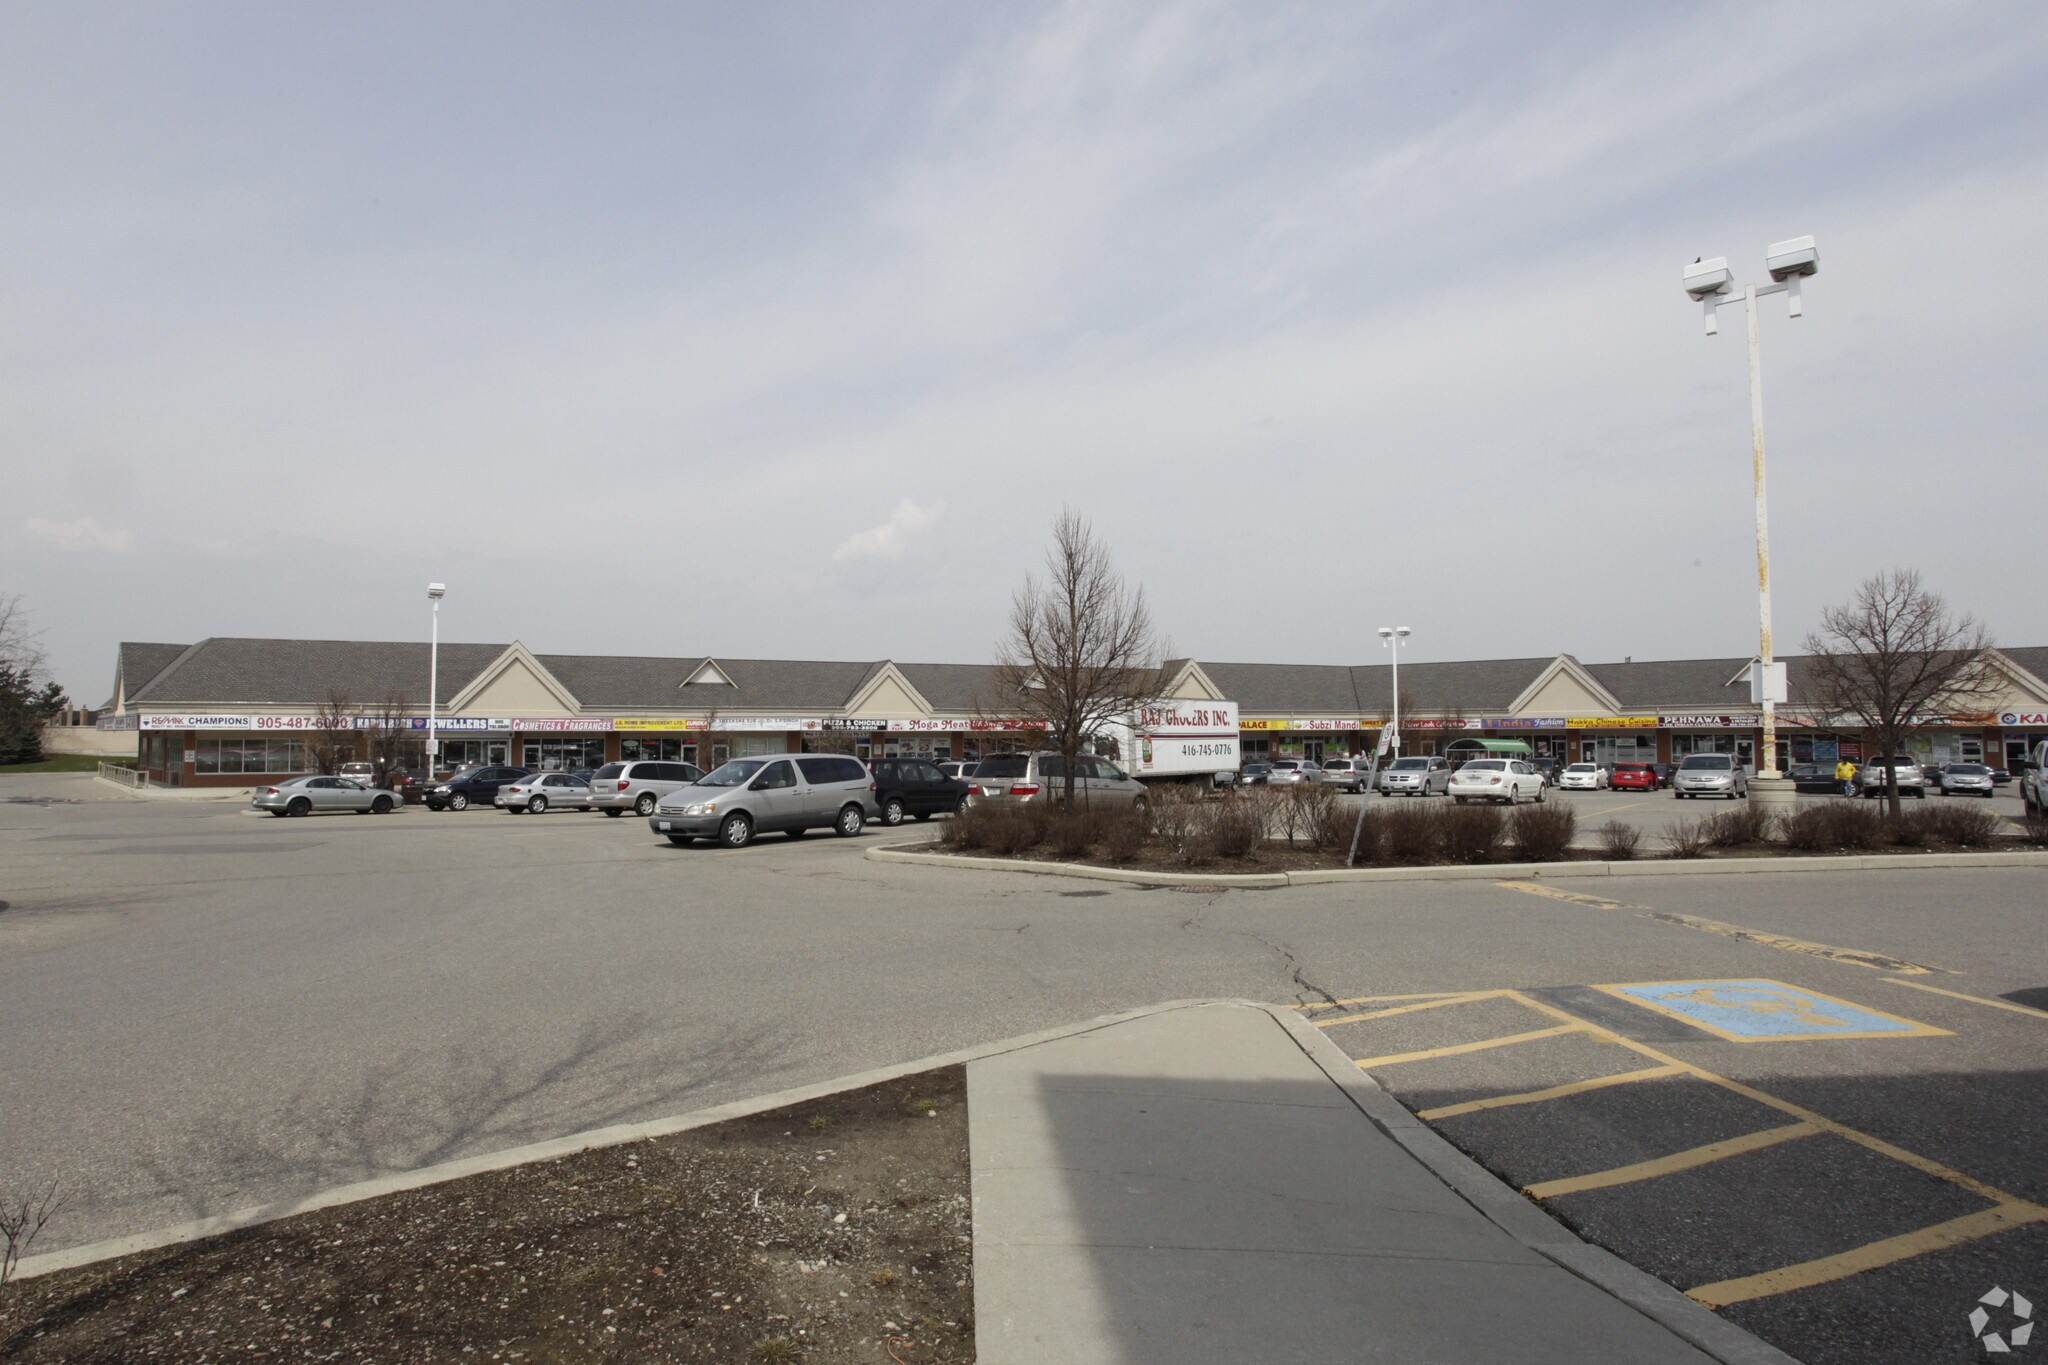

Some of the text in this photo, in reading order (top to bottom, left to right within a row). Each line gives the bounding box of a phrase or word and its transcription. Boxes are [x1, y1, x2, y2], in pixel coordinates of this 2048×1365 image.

[151, 716, 249, 725] RE/MAX CHAMPIONS
[1141, 708, 1161, 726] RAJ
[1212, 710, 1230, 727] INC.
[1596, 717, 1626, 725] Chinese
[1664, 716, 1721, 724] PEHNAWA
[2020, 713, 2048, 724] KA
[425, 718, 487, 729] JEWELLERS
[513, 719, 556, 731] COSMETICS
[564, 719, 611, 731] FRAGRANCES
[909, 720, 969, 730] Moga Meat
[1309, 720, 1359, 729] Subzi Mandi
[1534, 719, 1564, 727] Fashion
[1182, 744, 1232, 756] 416-745-0776
